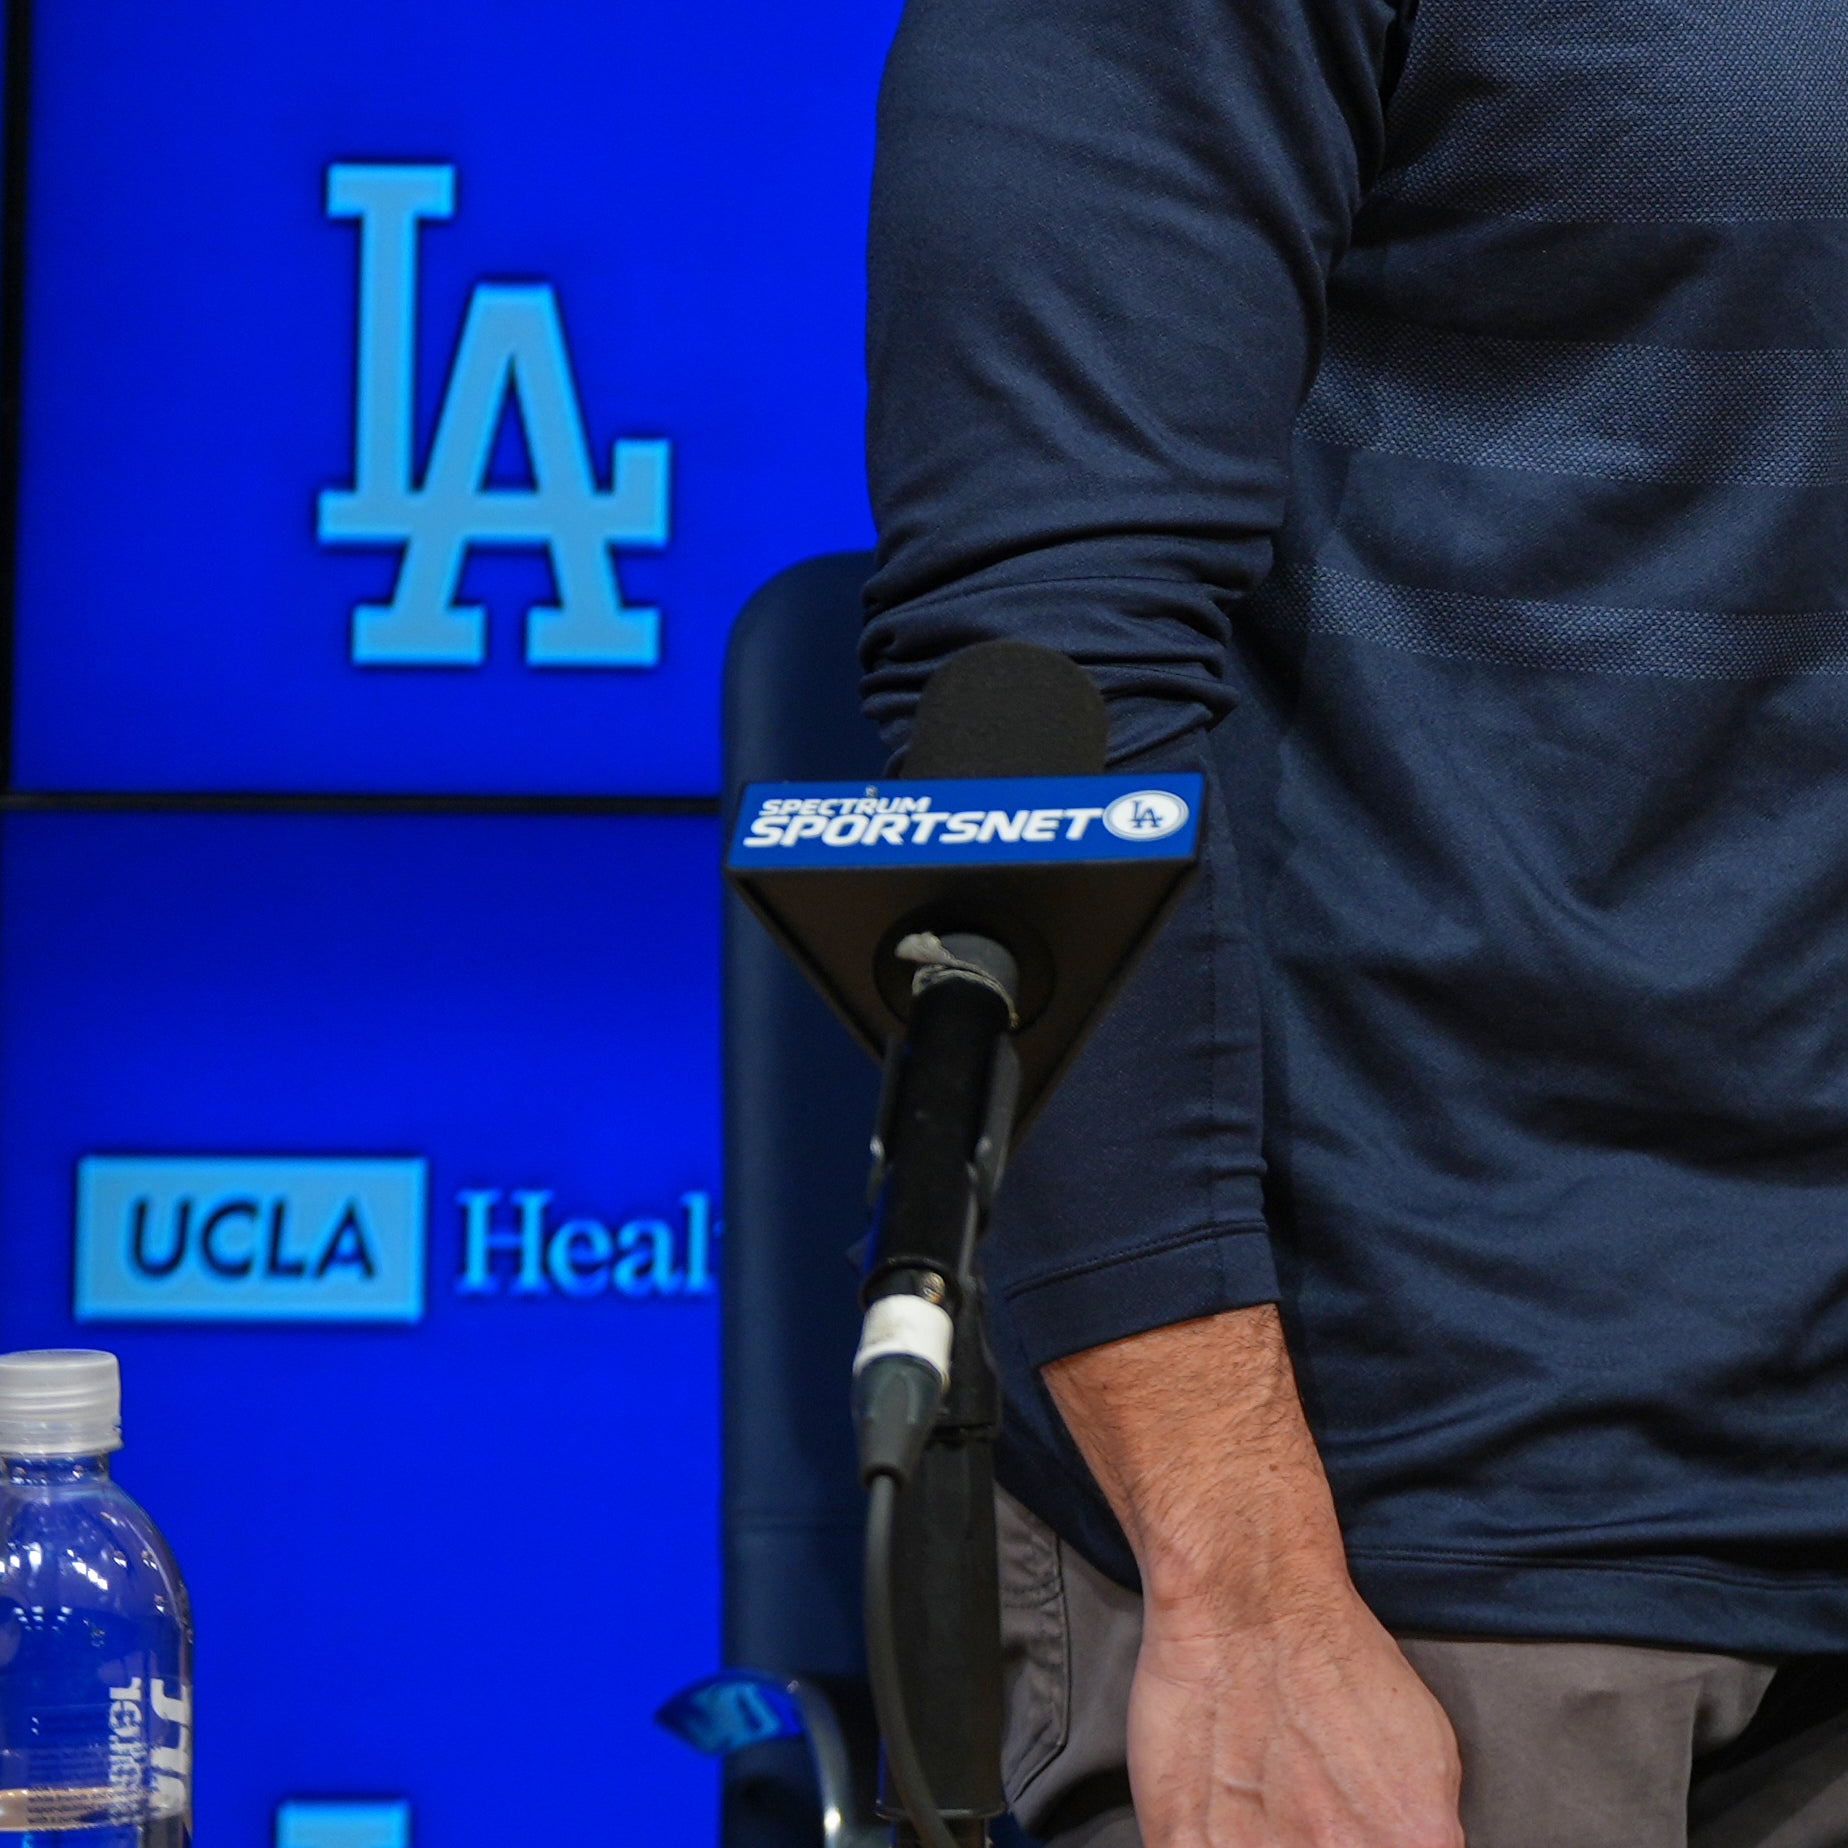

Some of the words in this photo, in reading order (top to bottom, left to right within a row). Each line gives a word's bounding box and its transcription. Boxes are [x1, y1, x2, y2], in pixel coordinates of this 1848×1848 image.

[317, 163, 671, 667] LA
[759, 797, 931, 816] SPECTRUM
[1130, 800, 1163, 828] LA
[743, 808, 1105, 847] SPORTSNET
[128, 1197, 377, 1280] UCLA
[456, 1189, 722, 1297] Heal
